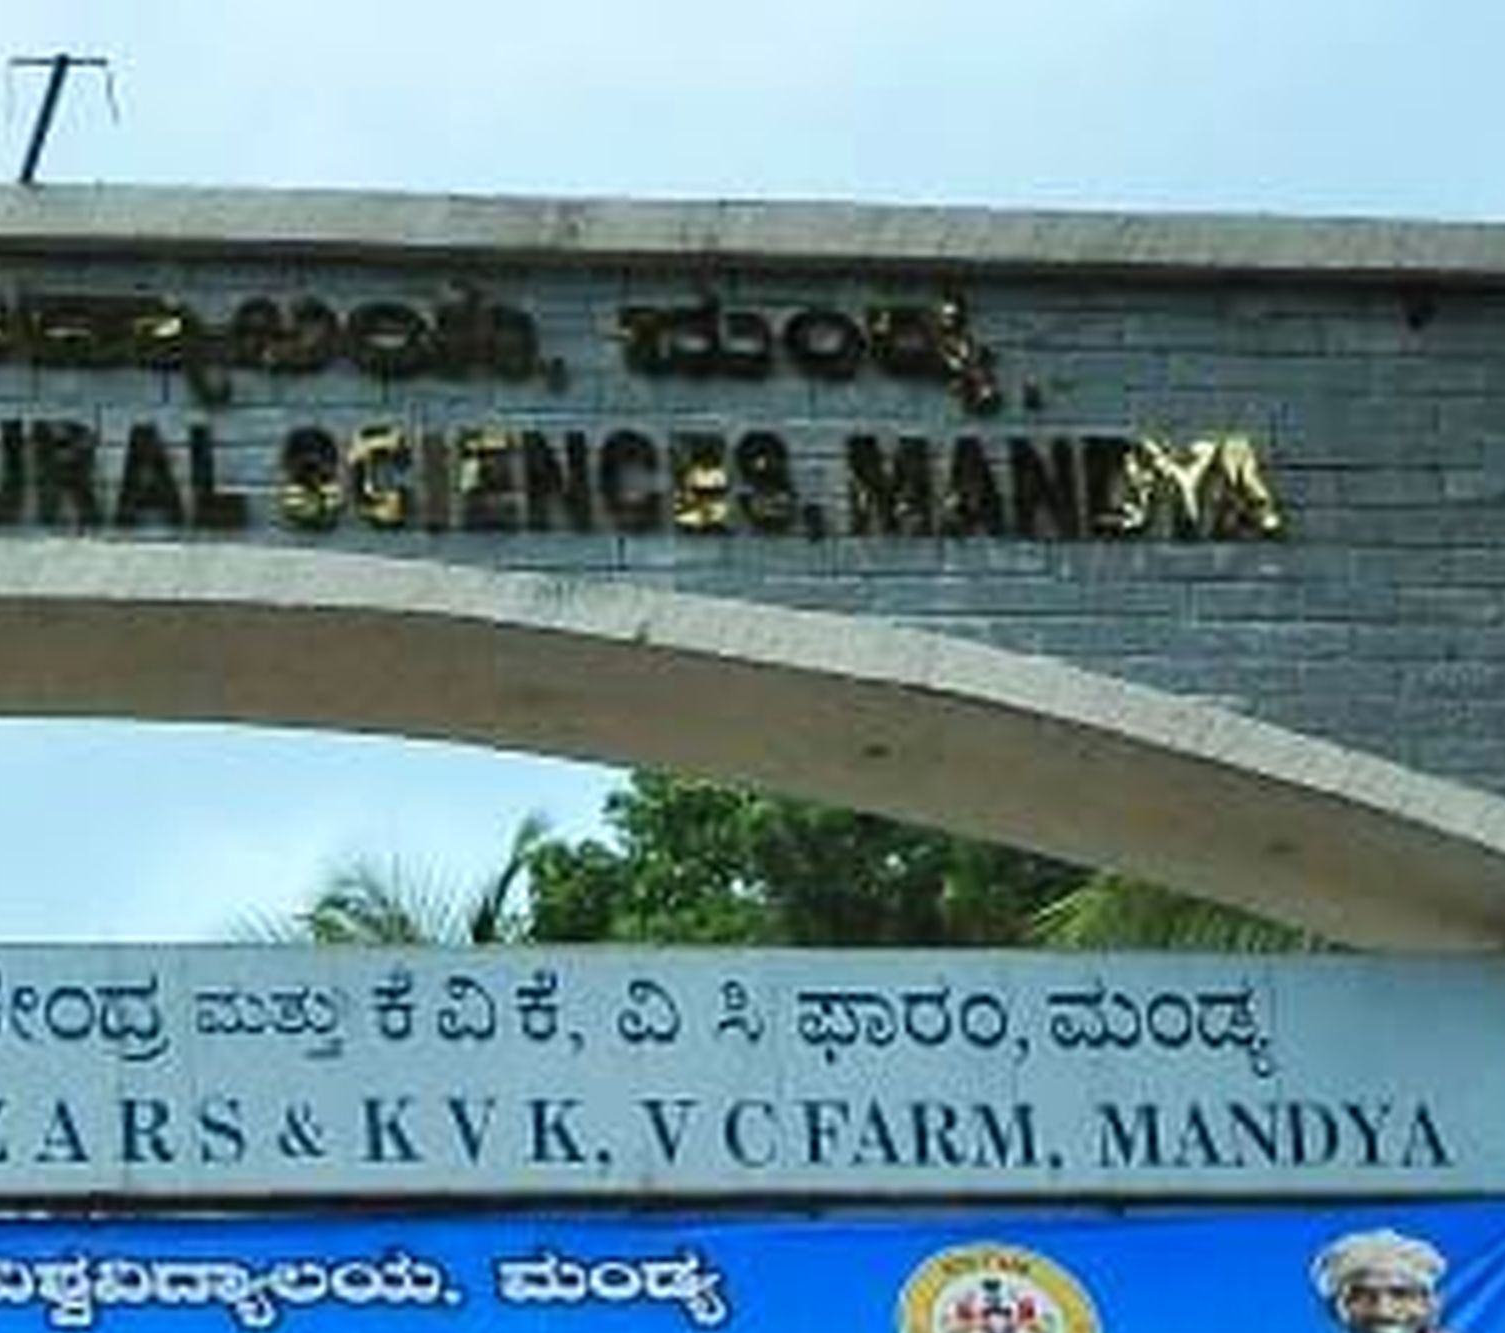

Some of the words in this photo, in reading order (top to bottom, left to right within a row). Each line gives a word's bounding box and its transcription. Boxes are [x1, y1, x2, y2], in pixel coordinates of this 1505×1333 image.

[847, 432, 1286, 541] MANDYA
[194, 985, 349, 1059] ಮತ್ತು
[1045, 980, 1279, 1084] ಮಂಡ್ಯ
[277, 1104, 325, 1158] &
[1096, 1099, 1454, 1169] MANDYA
[498, 1254, 728, 1326] ಮಂಡ್ಯ
